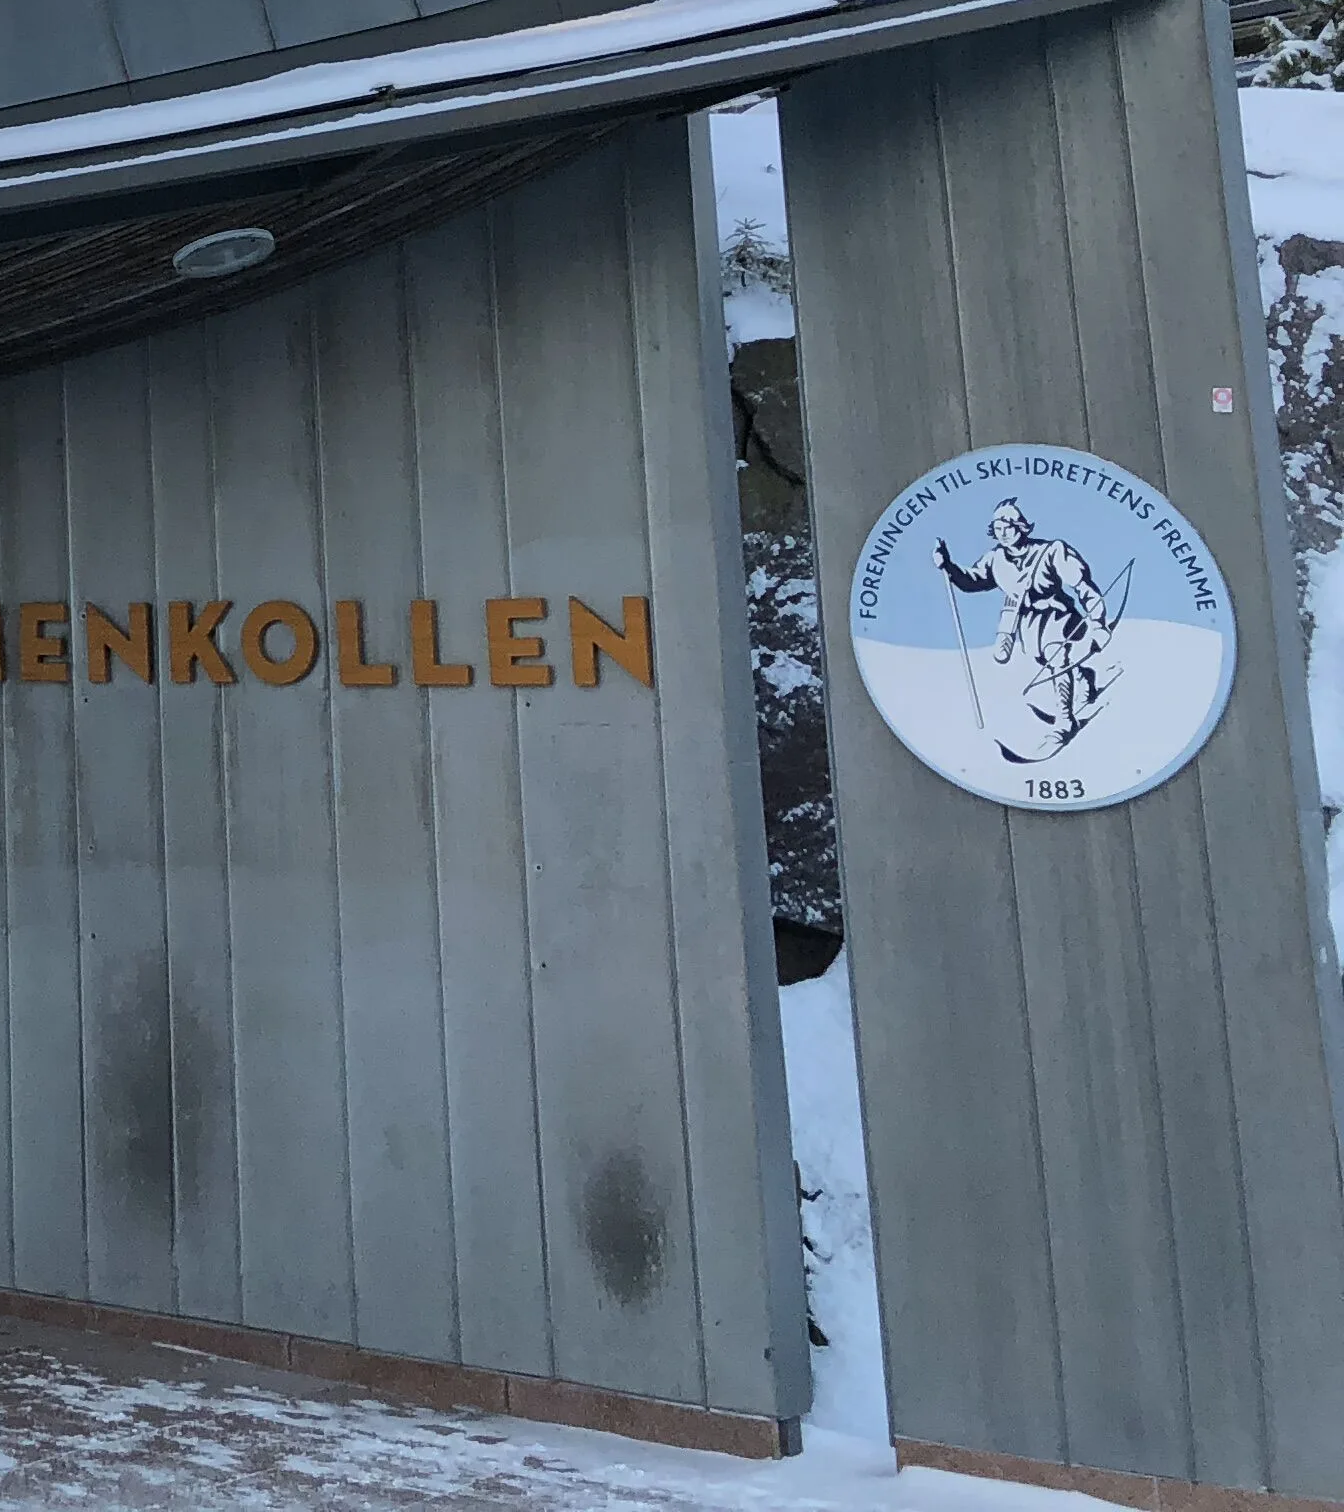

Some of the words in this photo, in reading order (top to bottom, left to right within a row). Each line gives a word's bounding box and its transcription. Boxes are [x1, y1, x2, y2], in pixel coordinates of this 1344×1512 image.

[859, 485, 939, 621] FORENINGEN
[934, 468, 972, 497] TIL
[975, 456, 1156, 521] SKI-IDRETTENS
[1151, 517, 1218, 612] FREMME
[1024, 778, 1086, 801] 1883
